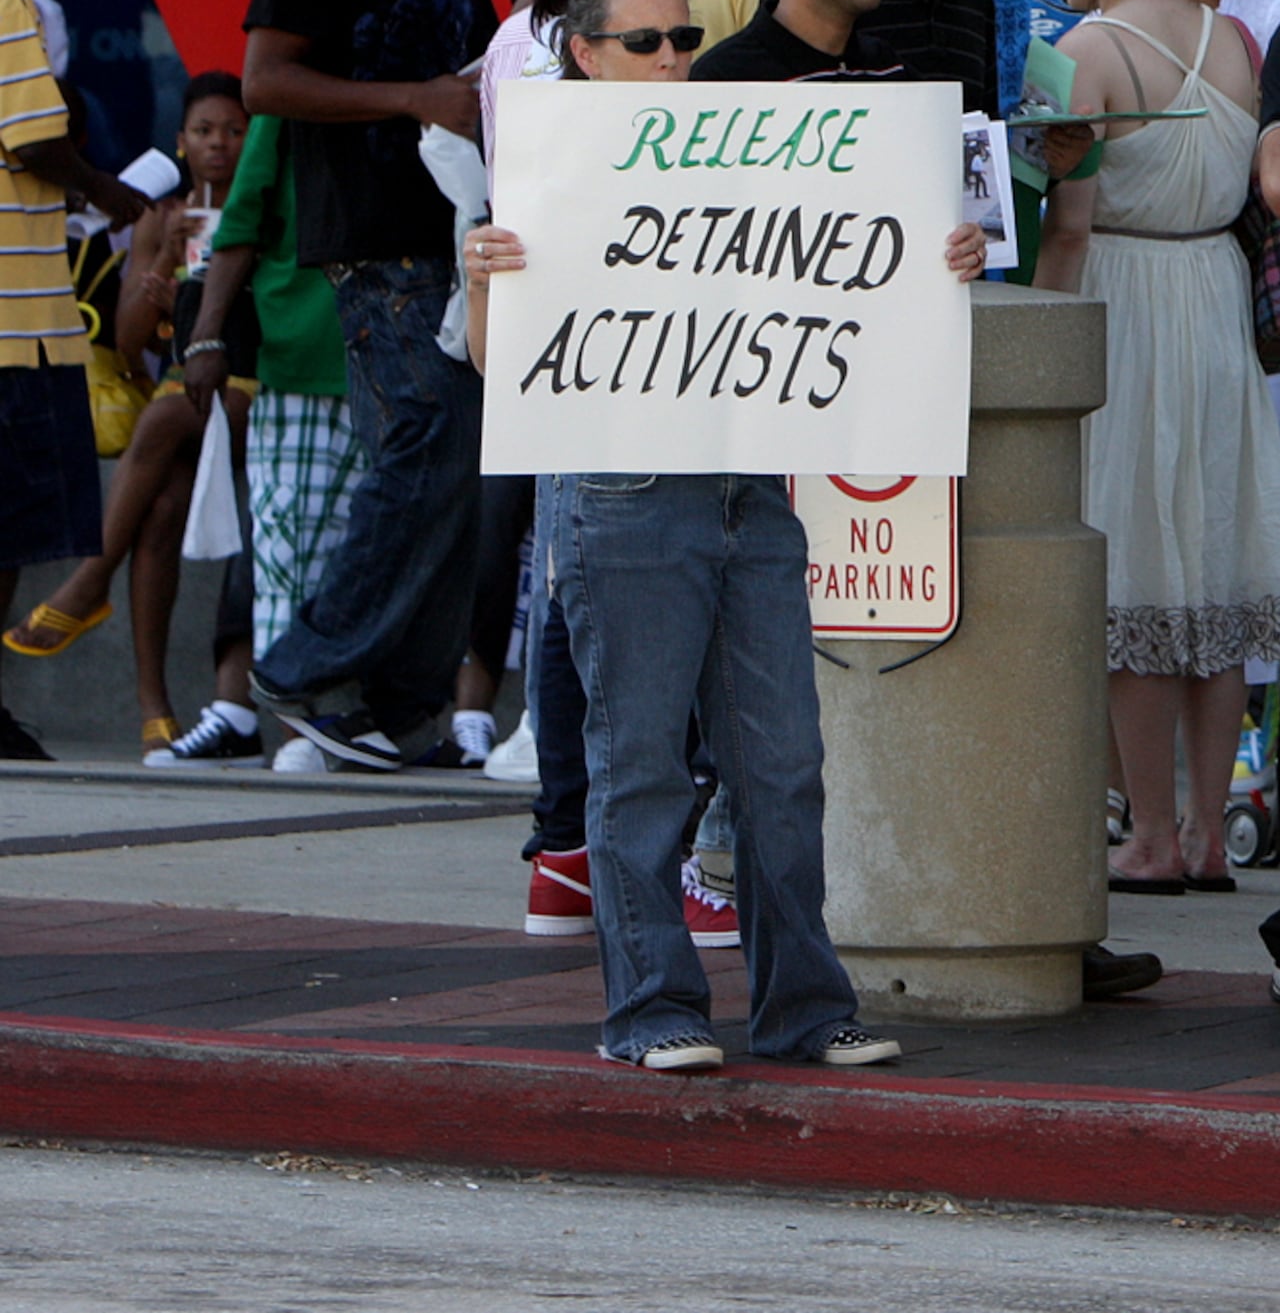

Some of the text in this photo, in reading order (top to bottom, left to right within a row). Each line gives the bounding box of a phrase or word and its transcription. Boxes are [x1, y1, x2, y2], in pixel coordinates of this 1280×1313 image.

[611, 106, 869, 172] RELEASE
[605, 205, 904, 291] DETAINED
[520, 307, 861, 409] ACTIVISTS
[851, 518, 893, 555] NO
[808, 563, 935, 601] PARKING
